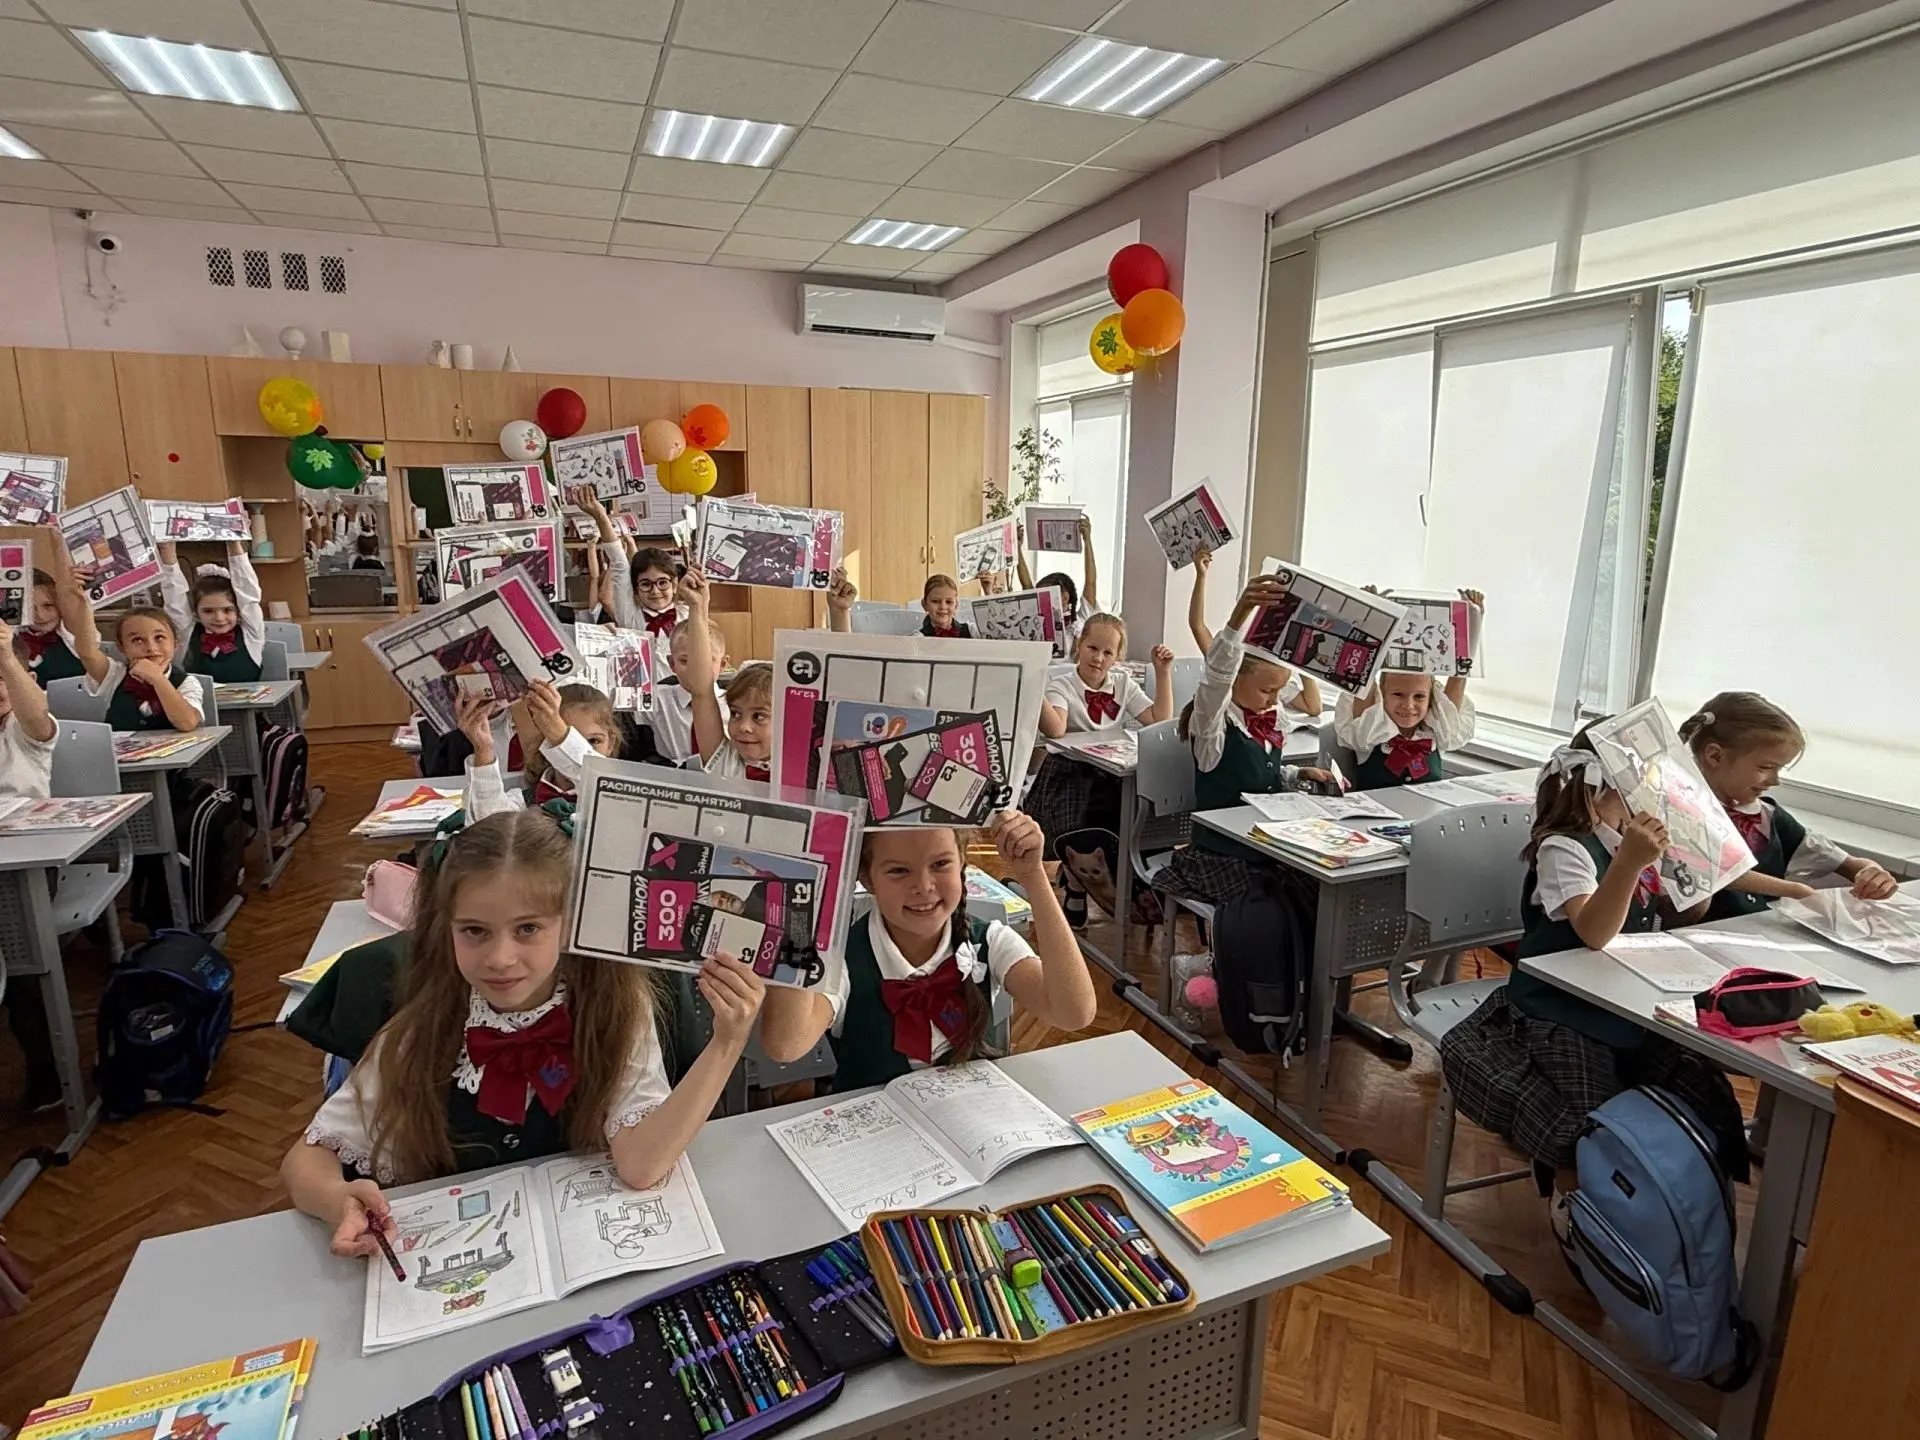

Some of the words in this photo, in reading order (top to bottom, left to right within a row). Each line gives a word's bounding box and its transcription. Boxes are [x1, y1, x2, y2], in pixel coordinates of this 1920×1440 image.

[790, 689, 817, 699] t2.ru
[983, 714, 1005, 783] ТРОЙНОЙ
[599, 779, 681, 800] РАСПИСАНИЕ
[684, 793, 742, 809] ЗАНЯТИЙ
[632, 874, 649, 952] ТРОЙНОЙ
[792, 882, 812, 904] t2
[658, 889, 677, 942] 300
